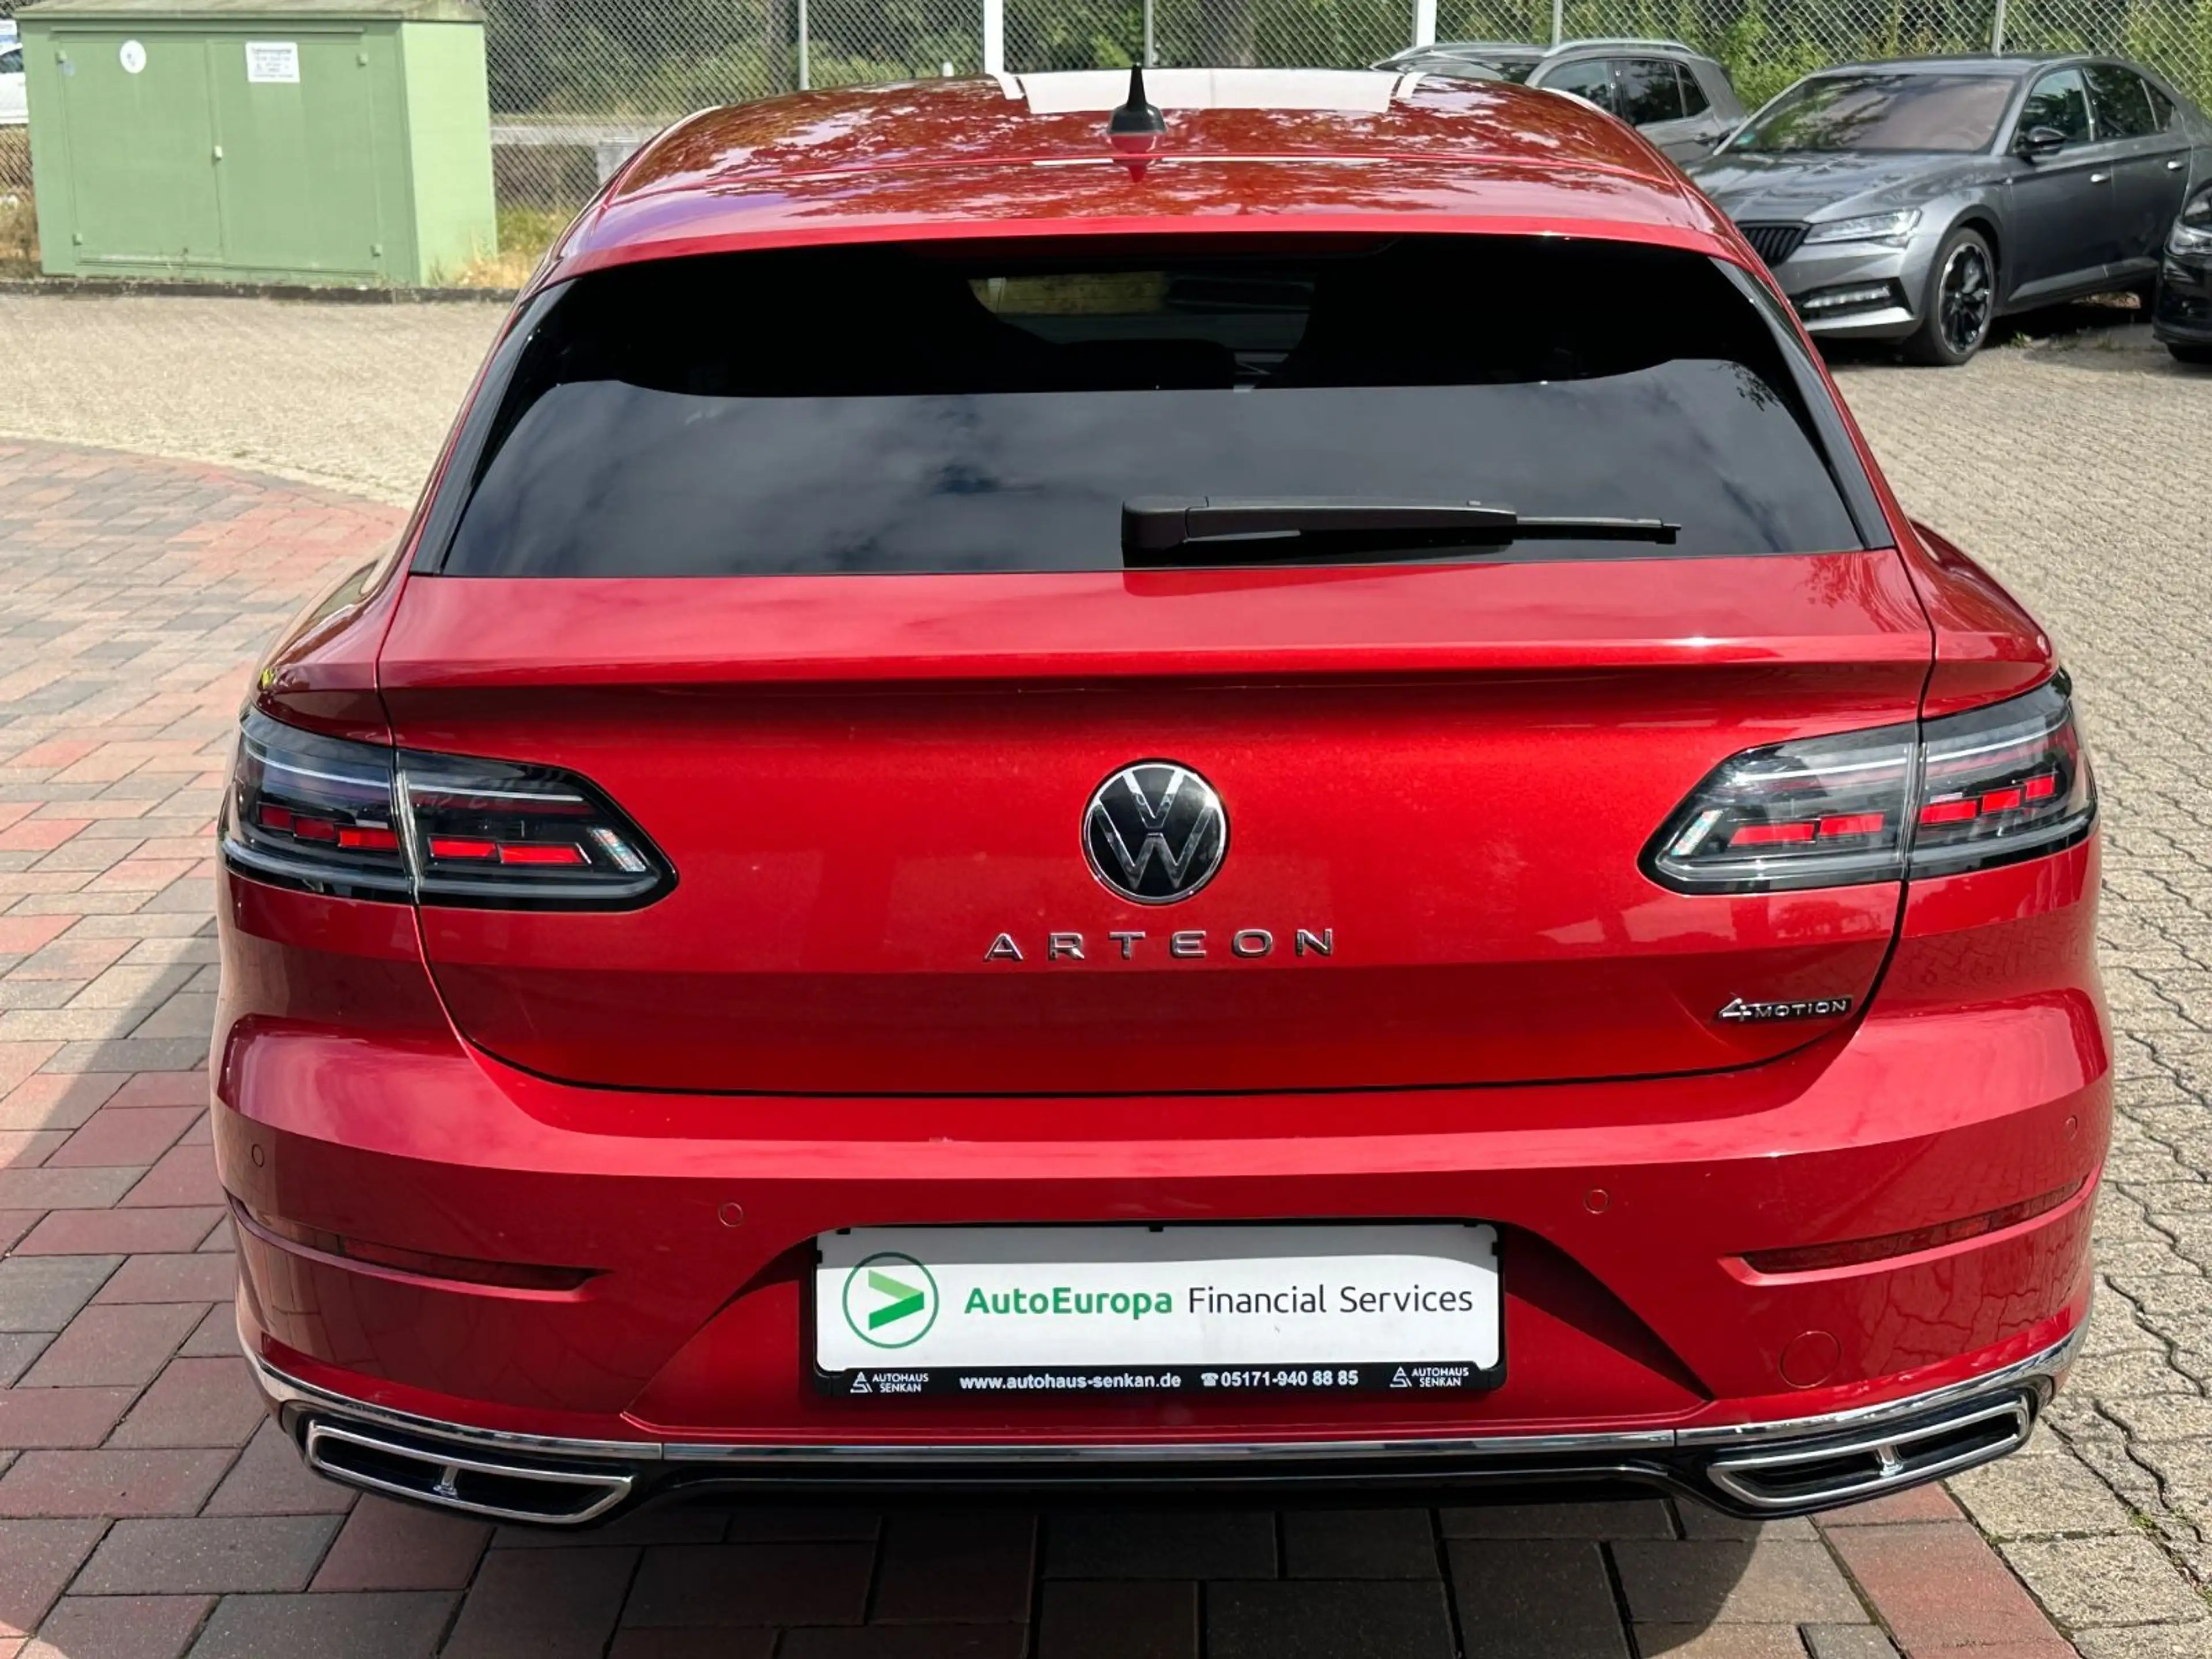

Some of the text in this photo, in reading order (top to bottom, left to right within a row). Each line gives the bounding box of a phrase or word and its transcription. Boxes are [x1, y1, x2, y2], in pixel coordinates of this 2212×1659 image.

[1089, 766, 1222, 895] VW
[984, 928, 1333, 961] ARTEON
[1718, 998, 1847, 1021] 4MOTION
[964, 1285, 1473, 1320] AutoEuropa Financial Services
[872, 1373, 929, 1382] AUTOHAUS
[959, 1373, 1181, 1389] www.autohaus-senkan.de
[1221, 1369, 1359, 1387] 05171-940 88 85
[1411, 1368, 1469, 1377] AUTOHAUS
[879, 1383, 922, 1393] SENKAN
[1419, 1377, 1461, 1388] SENKAN
